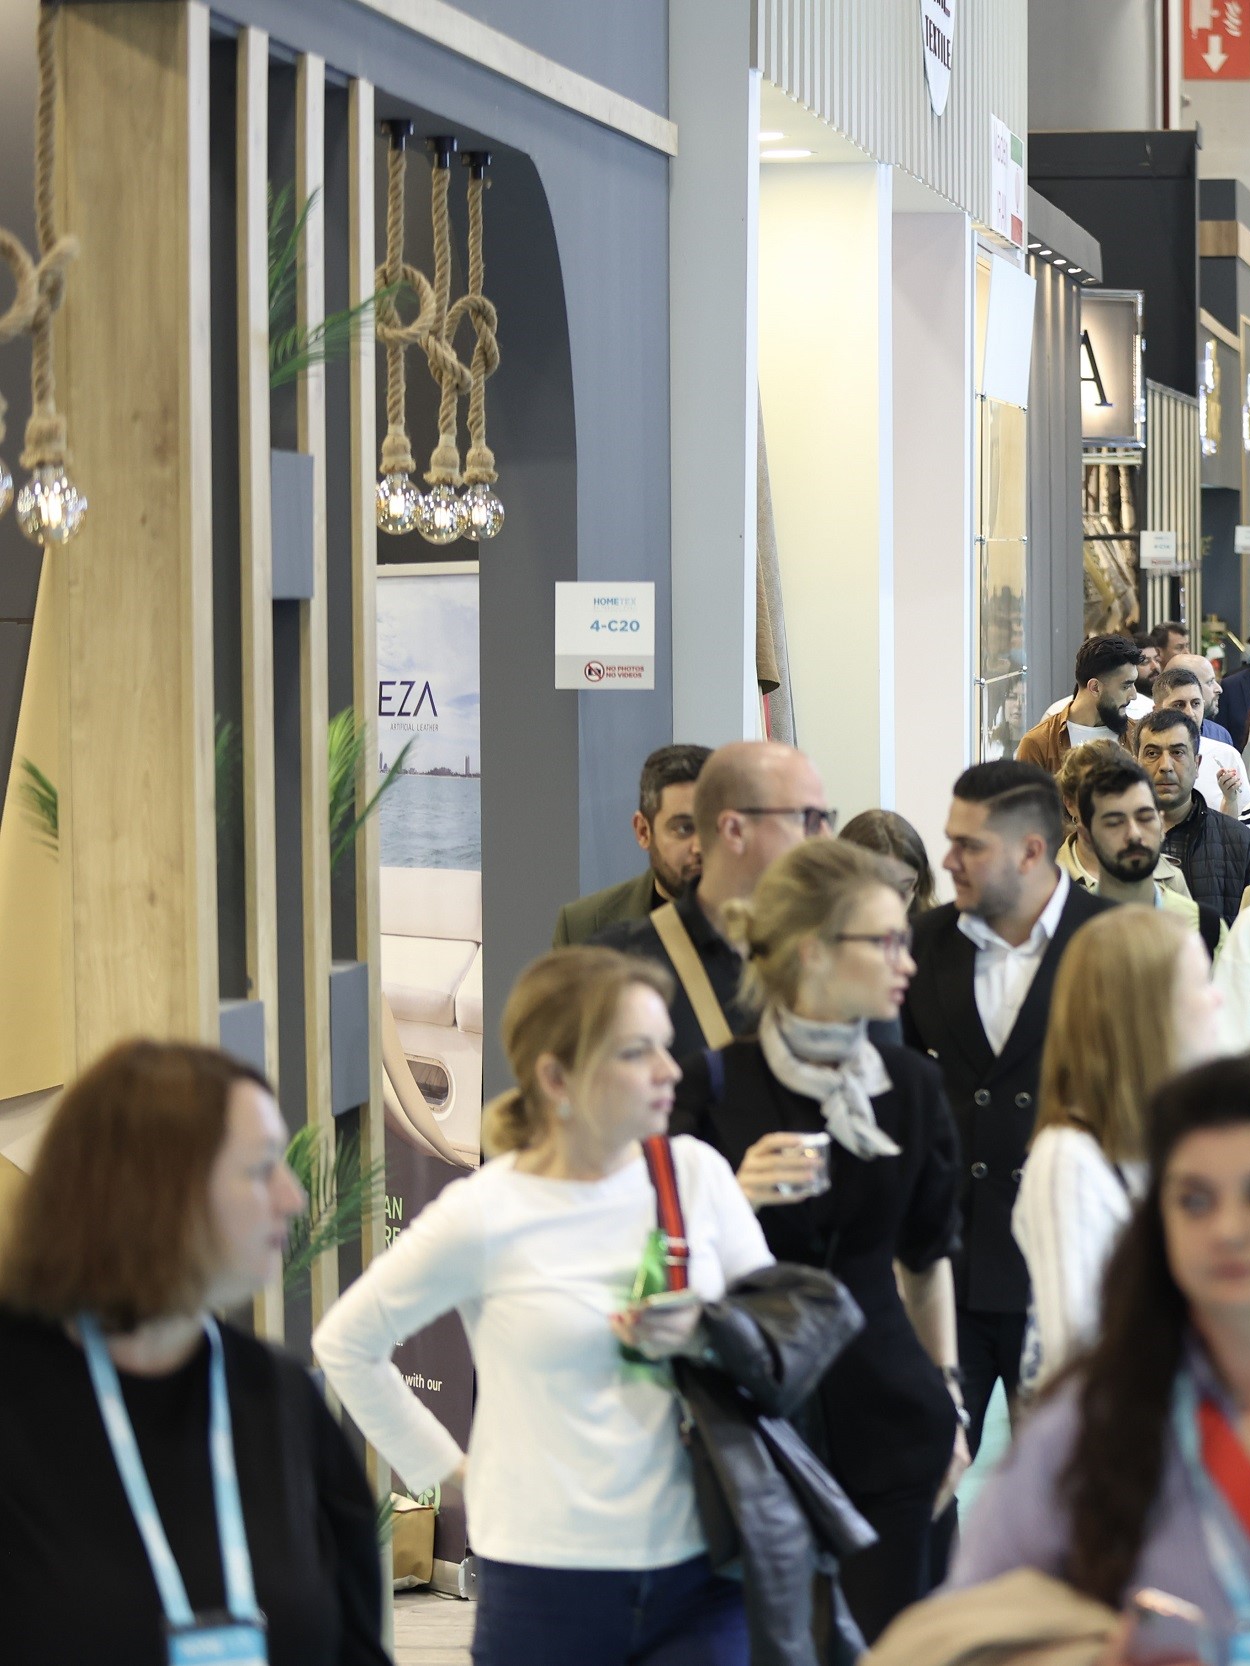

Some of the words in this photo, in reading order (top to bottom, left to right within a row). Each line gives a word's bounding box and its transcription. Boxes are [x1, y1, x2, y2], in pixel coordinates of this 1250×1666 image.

[925, 14, 951, 70] TEXTILE
[590, 620, 640, 632] 4-C20
[390, 723, 415, 732] ARTIFICIAL
[417, 723, 439, 732] LEATHER
[405, 1373, 425, 1389] with
[427, 1379, 443, 1392] our
